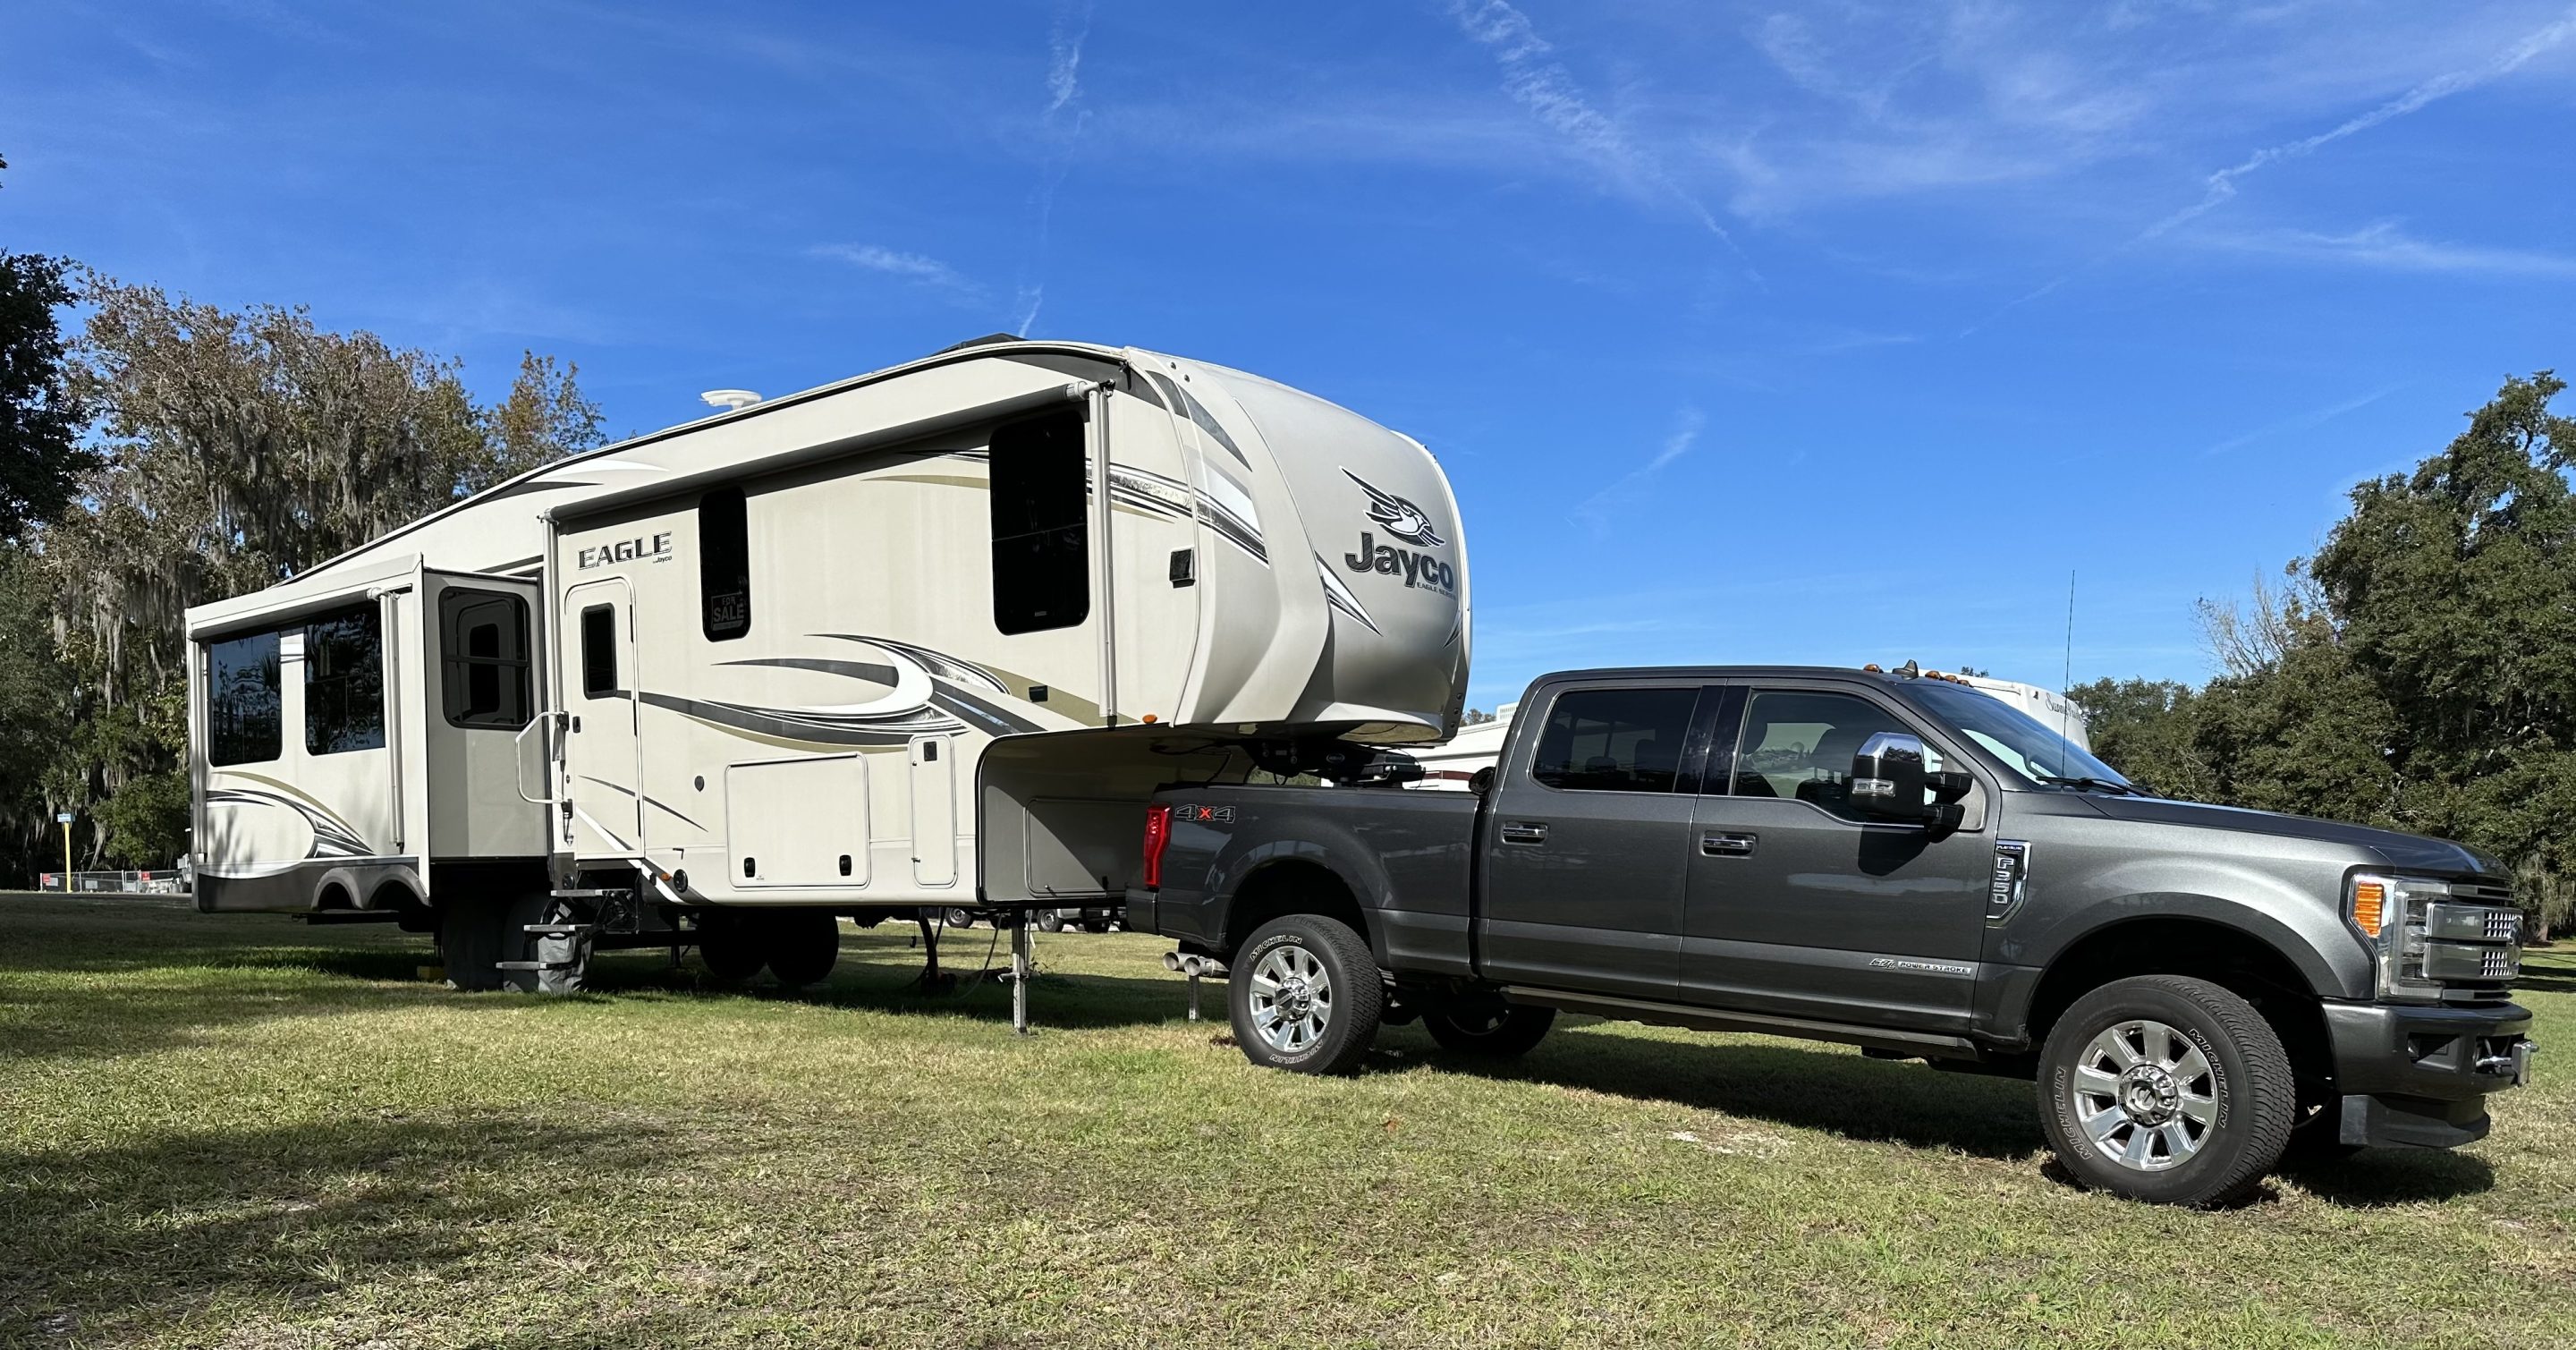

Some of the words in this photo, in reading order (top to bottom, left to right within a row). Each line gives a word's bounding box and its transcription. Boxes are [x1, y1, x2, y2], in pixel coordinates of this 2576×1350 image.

[578, 531, 673, 571] EAGLE
[1344, 531, 1454, 591] Jayco
[722, 596, 736, 606] FOR
[1417, 582, 1438, 593] EAGLE
[714, 603, 744, 623] SALE
[1993, 857, 2015, 904] F350
[1250, 934, 1302, 962] MICHELIN
[1900, 962, 1931, 971] POWER
[1933, 965, 1970, 974] STROKE
[1269, 1039, 1324, 1065] MICHELIN
[2189, 1029, 2229, 1129] MICHELIN
[2054, 1066, 2093, 1160] MICHELIN
